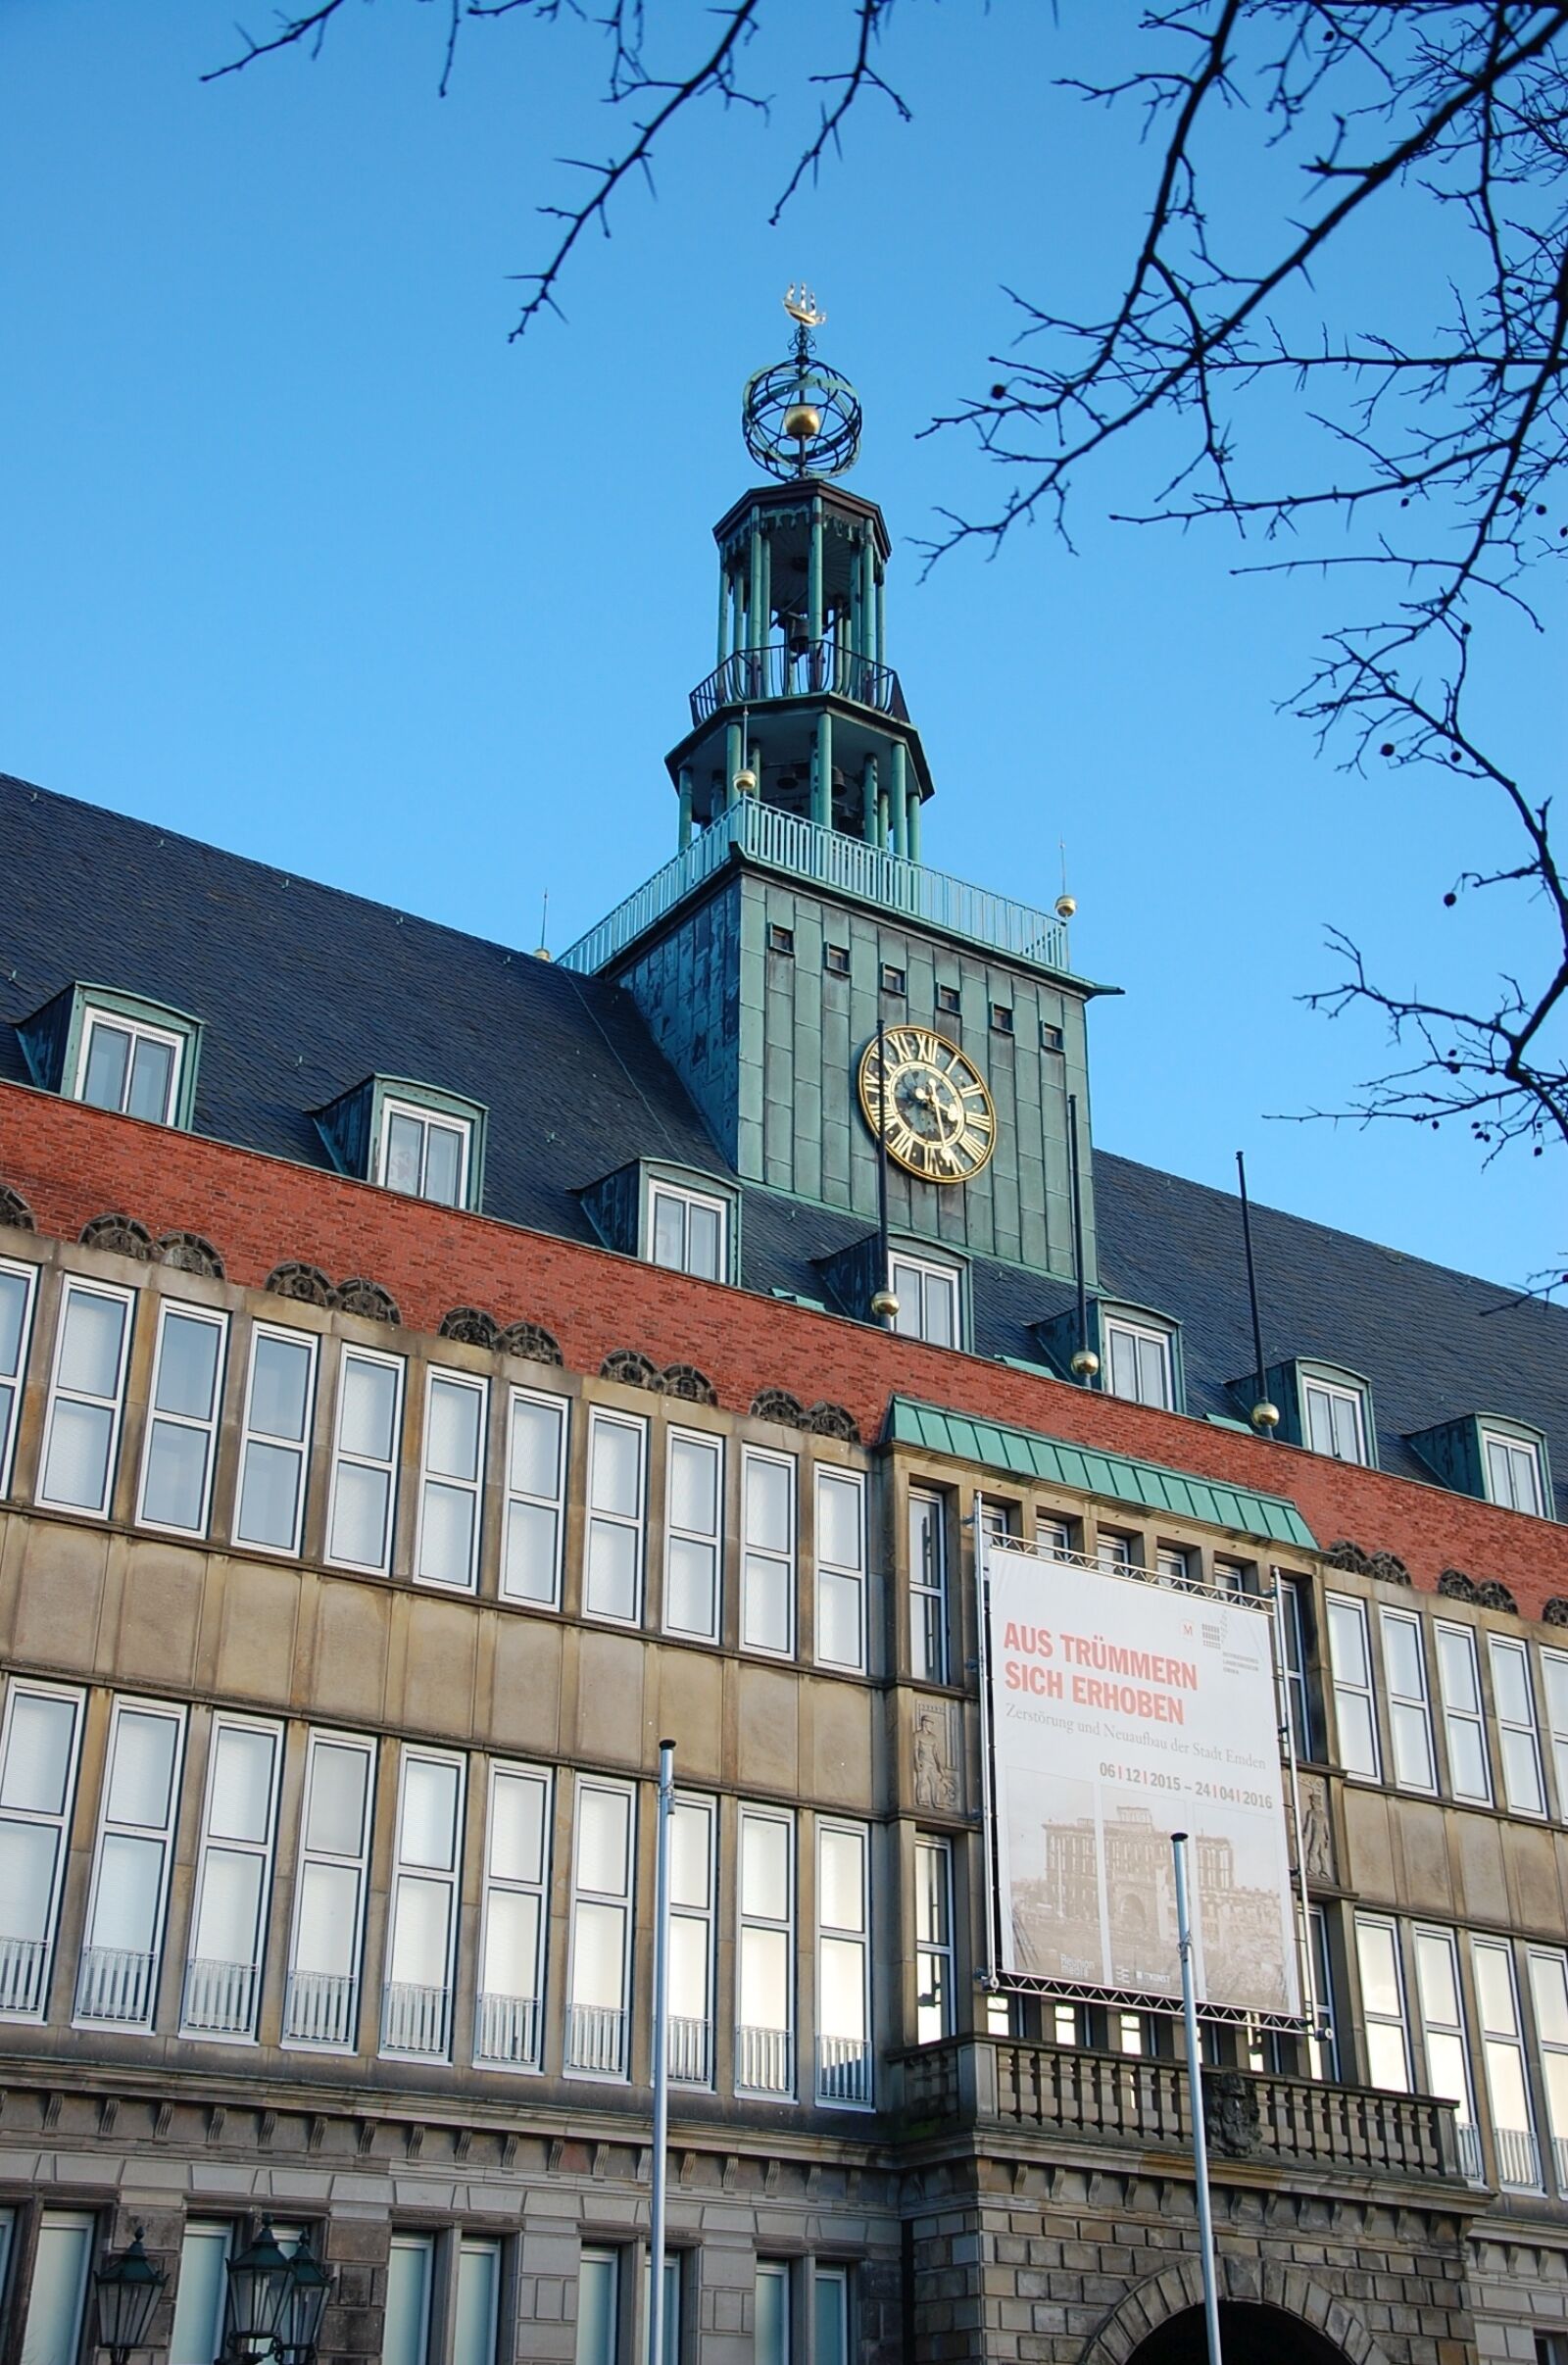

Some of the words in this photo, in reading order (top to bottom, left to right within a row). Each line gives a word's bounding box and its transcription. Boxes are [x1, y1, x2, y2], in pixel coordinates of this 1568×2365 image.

[887, 1032, 913, 1063] XI
[915, 1032, 939, 1064] XII
[957, 1083, 984, 1099] II
[965, 1110, 991, 1133] III
[890, 1129, 914, 1162] VII
[957, 1130, 987, 1163] IIII
[1004, 1622, 1054, 1658] AUS
[1059, 1634, 1198, 1691] TRÜMMERN
[1004, 1660, 1063, 1700] SICH
[1072, 1674, 1185, 1726] ERHOBEN
[1005, 1702, 1074, 1734] Zerstörung
[1077, 1719, 1101, 1736] und
[1103, 1722, 1168, 1749] Neuaufbau
[1171, 1737, 1189, 1754] der
[1193, 1742, 1223, 1761] Stadt
[1225, 1749, 1266, 1770] Emden
